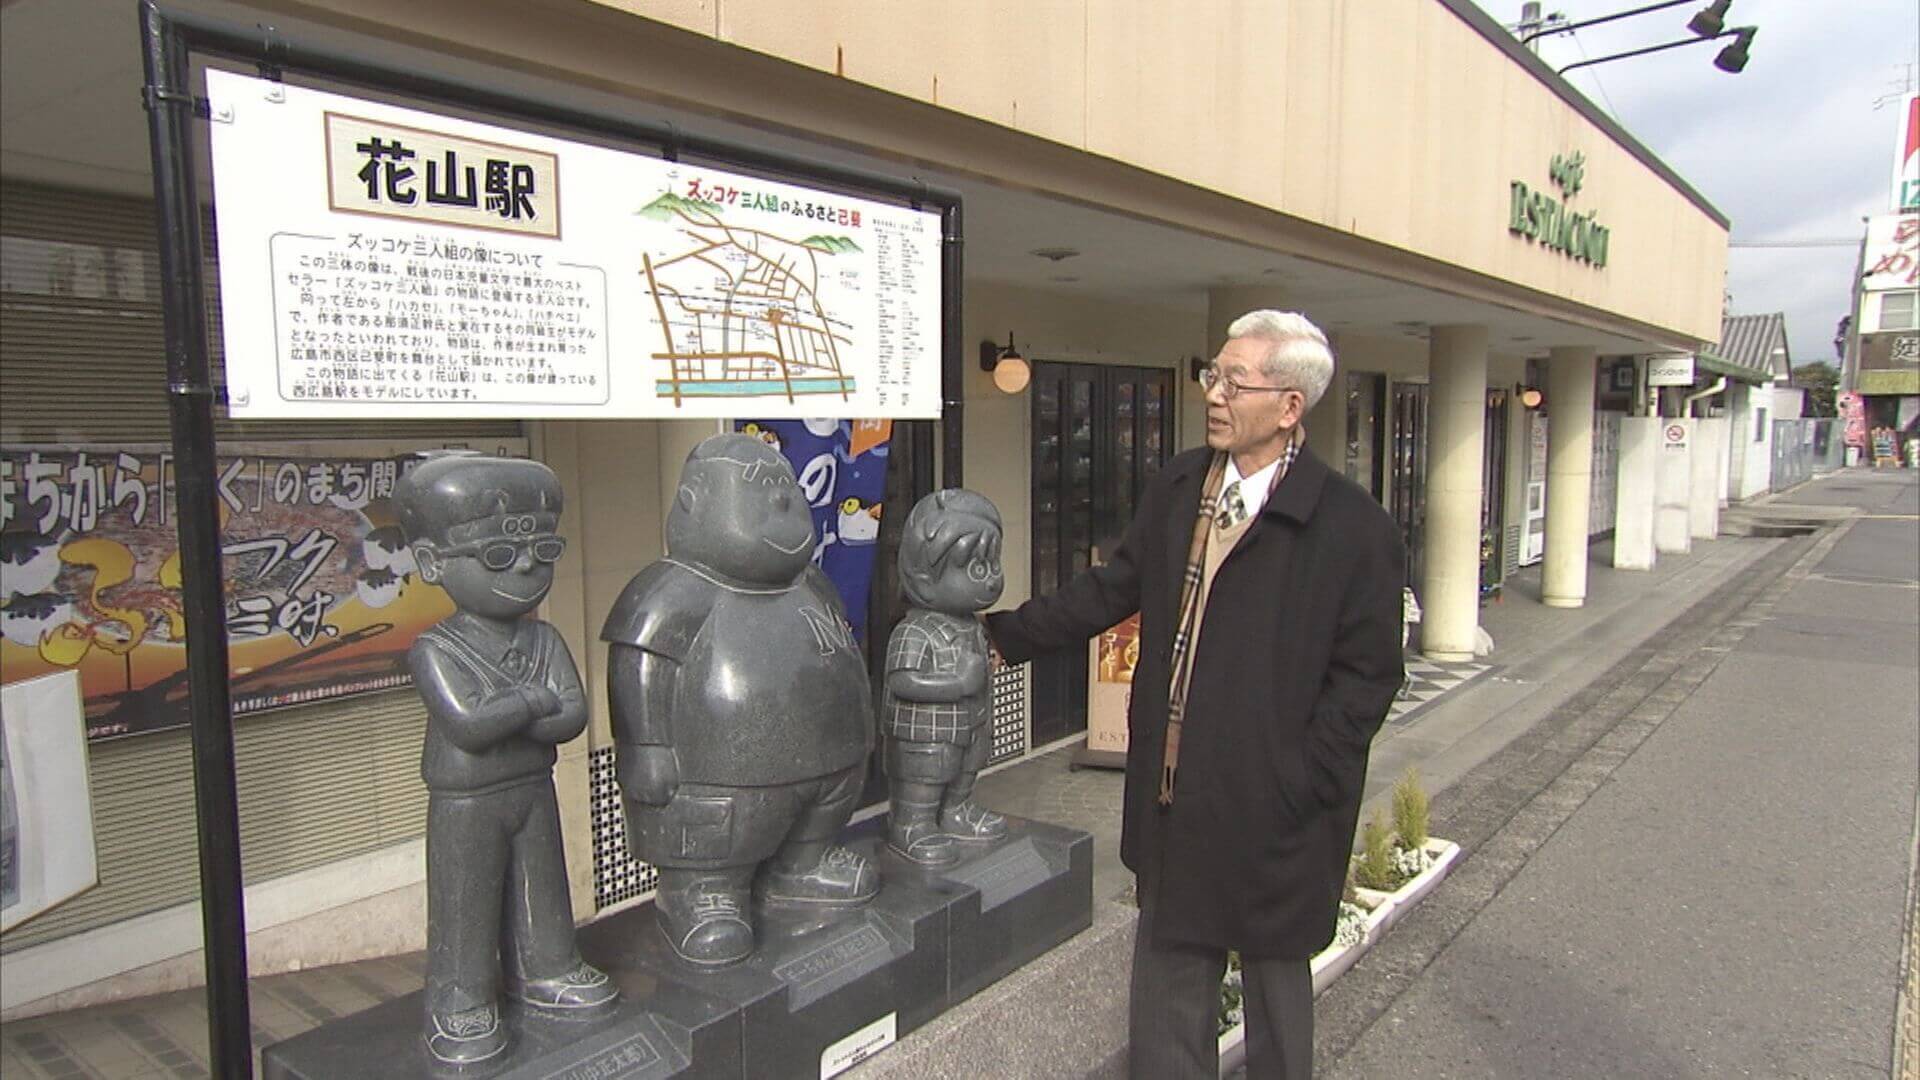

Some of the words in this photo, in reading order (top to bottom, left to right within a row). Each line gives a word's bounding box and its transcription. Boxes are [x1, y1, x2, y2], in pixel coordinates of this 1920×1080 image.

[357, 137, 536, 220] 花山駅
[348, 233, 543, 268] ズッコケ三人組の像について
